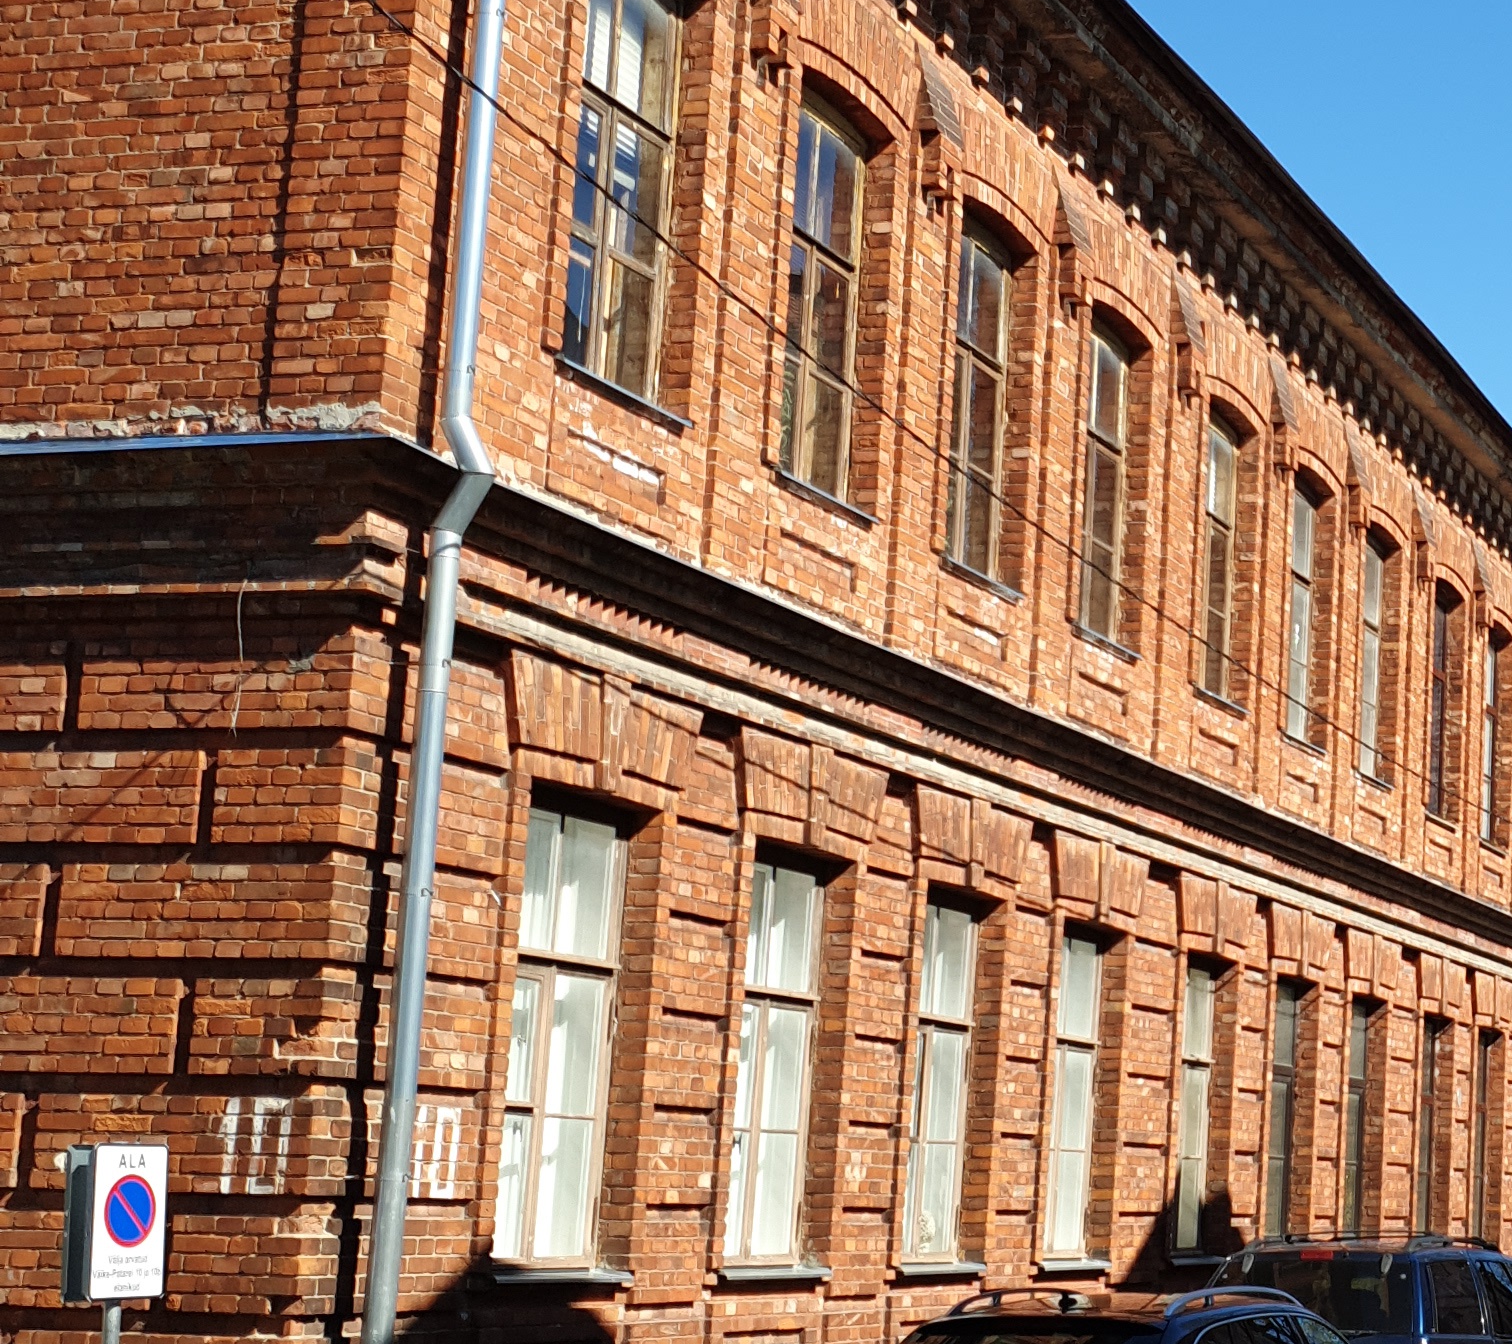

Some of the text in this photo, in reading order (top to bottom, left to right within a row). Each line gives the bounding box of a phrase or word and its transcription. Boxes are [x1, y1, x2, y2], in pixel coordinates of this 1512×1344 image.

[119, 1154, 146, 1168] ALA
[218, 1096, 293, 1195] 10
[412, 1105, 462, 1198] 10
